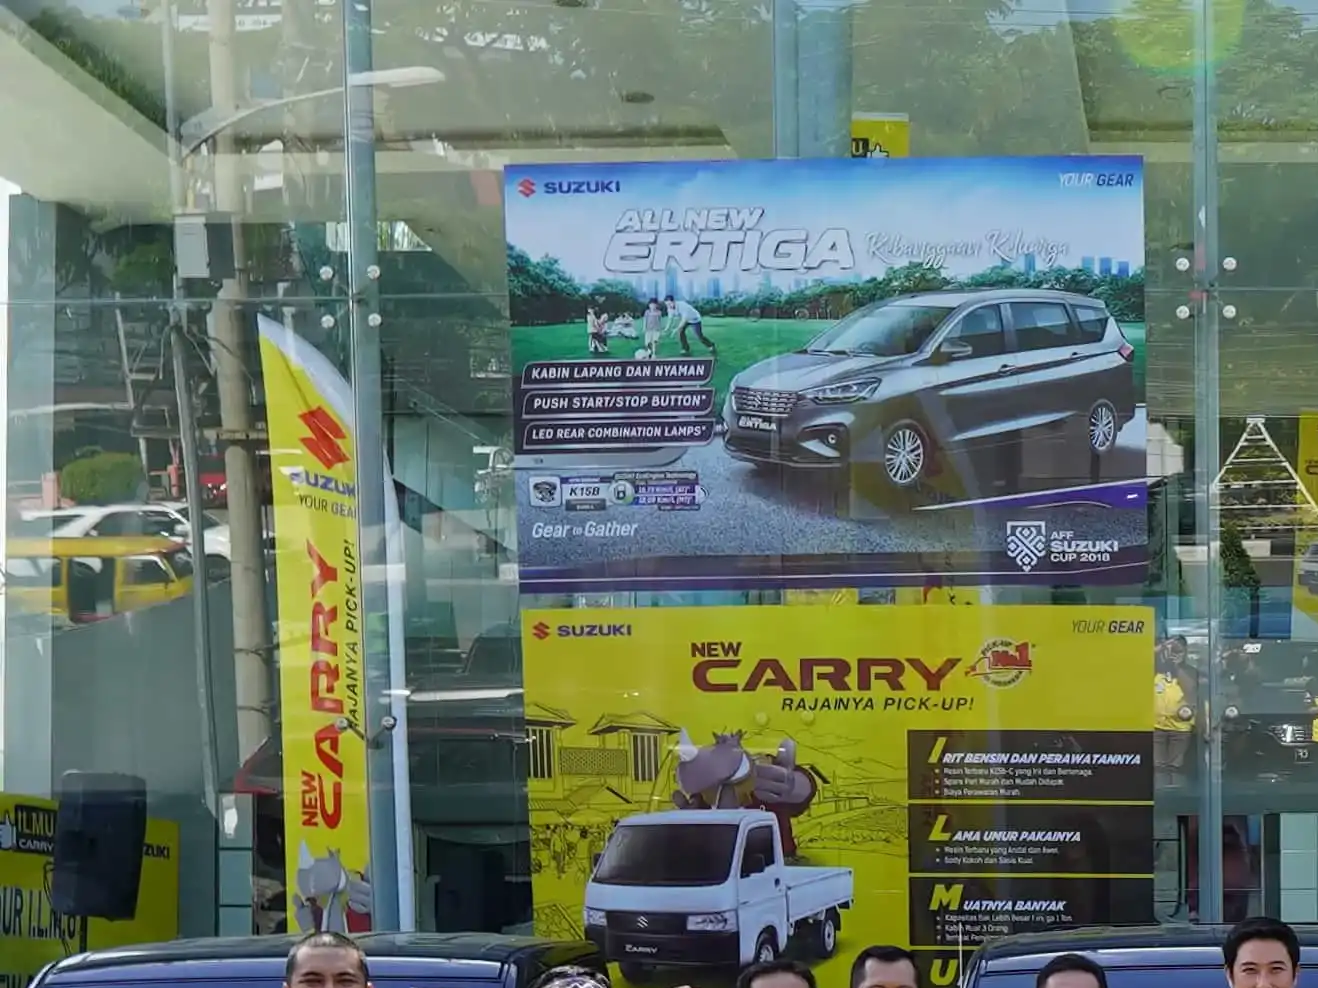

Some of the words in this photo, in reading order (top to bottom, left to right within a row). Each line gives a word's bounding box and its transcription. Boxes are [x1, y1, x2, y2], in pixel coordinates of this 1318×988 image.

[543, 179, 620, 195] SUZUKI
[1059, 172, 1094, 188] YOUR
[1096, 173, 1134, 188] GEAR
[615, 207, 682, 232] ALL
[682, 207, 765, 232] NEW
[603, 229, 855, 273] ERTIGA
[531, 367, 570, 379] KABIN
[573, 366, 622, 378] LAPANG
[626, 366, 650, 377] DAN
[655, 365, 705, 376] NYAMAN
[534, 397, 568, 409] PUSH
[572, 396, 648, 409] START/STOP
[532, 428, 553, 440] LED
[556, 428, 585, 439] REAR
[588, 426, 661, 438] COMBINATION
[299, 494, 328, 512] YOUR
[532, 522, 571, 538] Gear
[584, 521, 638, 538] Gather
[1050, 531, 1074, 540] AFF
[1050, 540, 1119, 553] SUZUKI
[1050, 553, 1077, 562] CUP
[1079, 553, 1110, 562] 2018
[344, 540, 358, 633] PICK-UP!
[557, 624, 632, 637] SUZUKI
[1072, 620, 1105, 634] YOUR
[1108, 620, 1145, 634] GEAR
[691, 642, 742, 657] NEW
[692, 658, 962, 692] CARRY
[306, 539, 344, 829] CARRY
[884, 697, 975, 711] PICK-UP!
[964, 753, 1010, 764] BENSIN
[1010, 753, 1039, 764] DAN
[1038, 753, 1141, 765] PERAWATANNYA
[301, 770, 319, 828] NEW
[983, 831, 1019, 841] UMUR
[19, 839, 53, 852] CARRY
[1014, 900, 1068, 911] BANYAK
